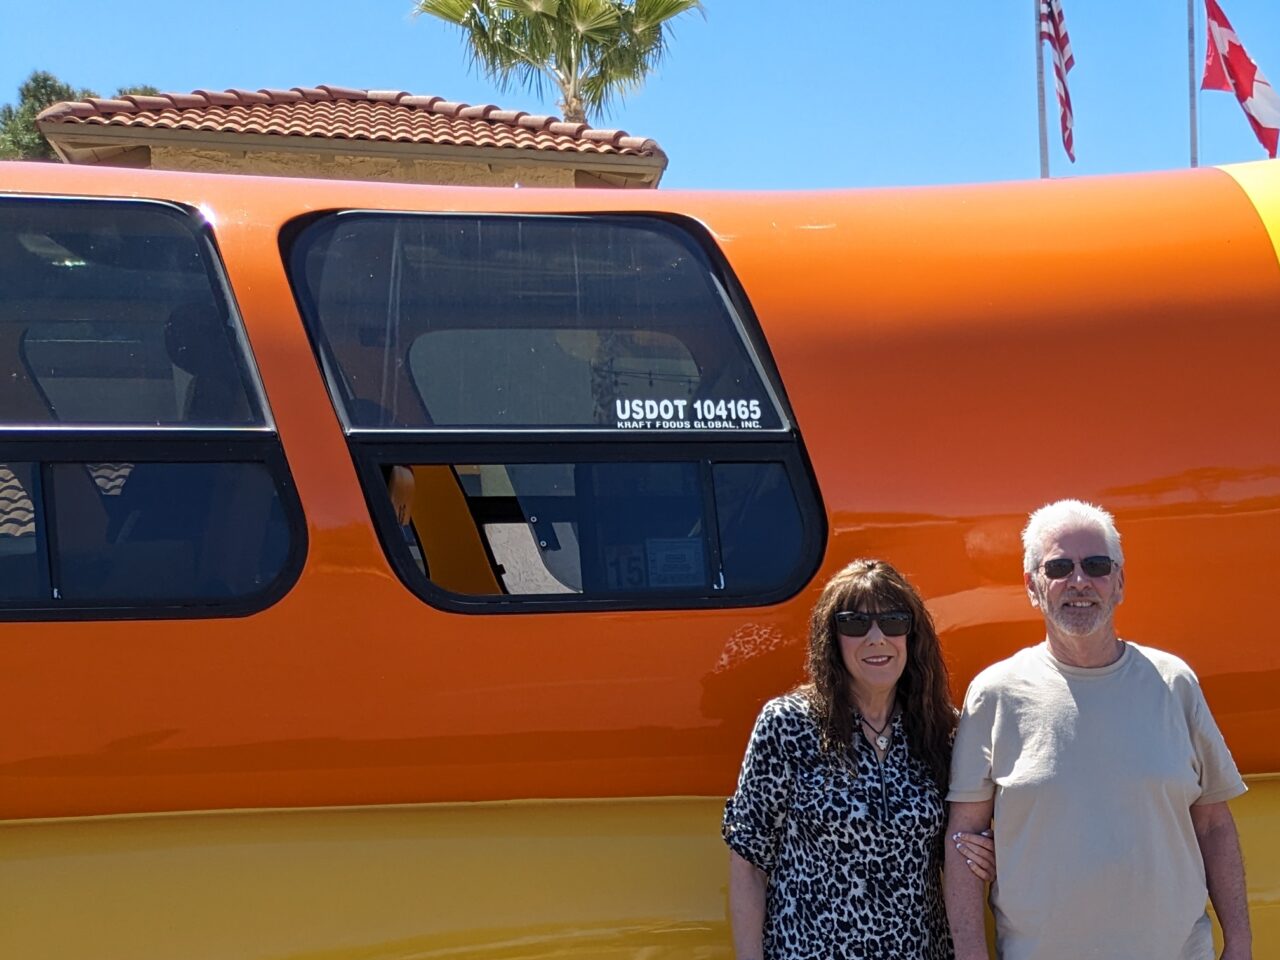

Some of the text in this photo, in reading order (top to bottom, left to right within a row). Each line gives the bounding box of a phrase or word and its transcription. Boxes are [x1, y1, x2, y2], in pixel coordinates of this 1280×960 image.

[615, 399, 762, 420] USDOT 104165
[617, 421, 651, 429] KRAFT
[655, 421, 691, 429] FOODS
[741, 420, 762, 429] INC.
